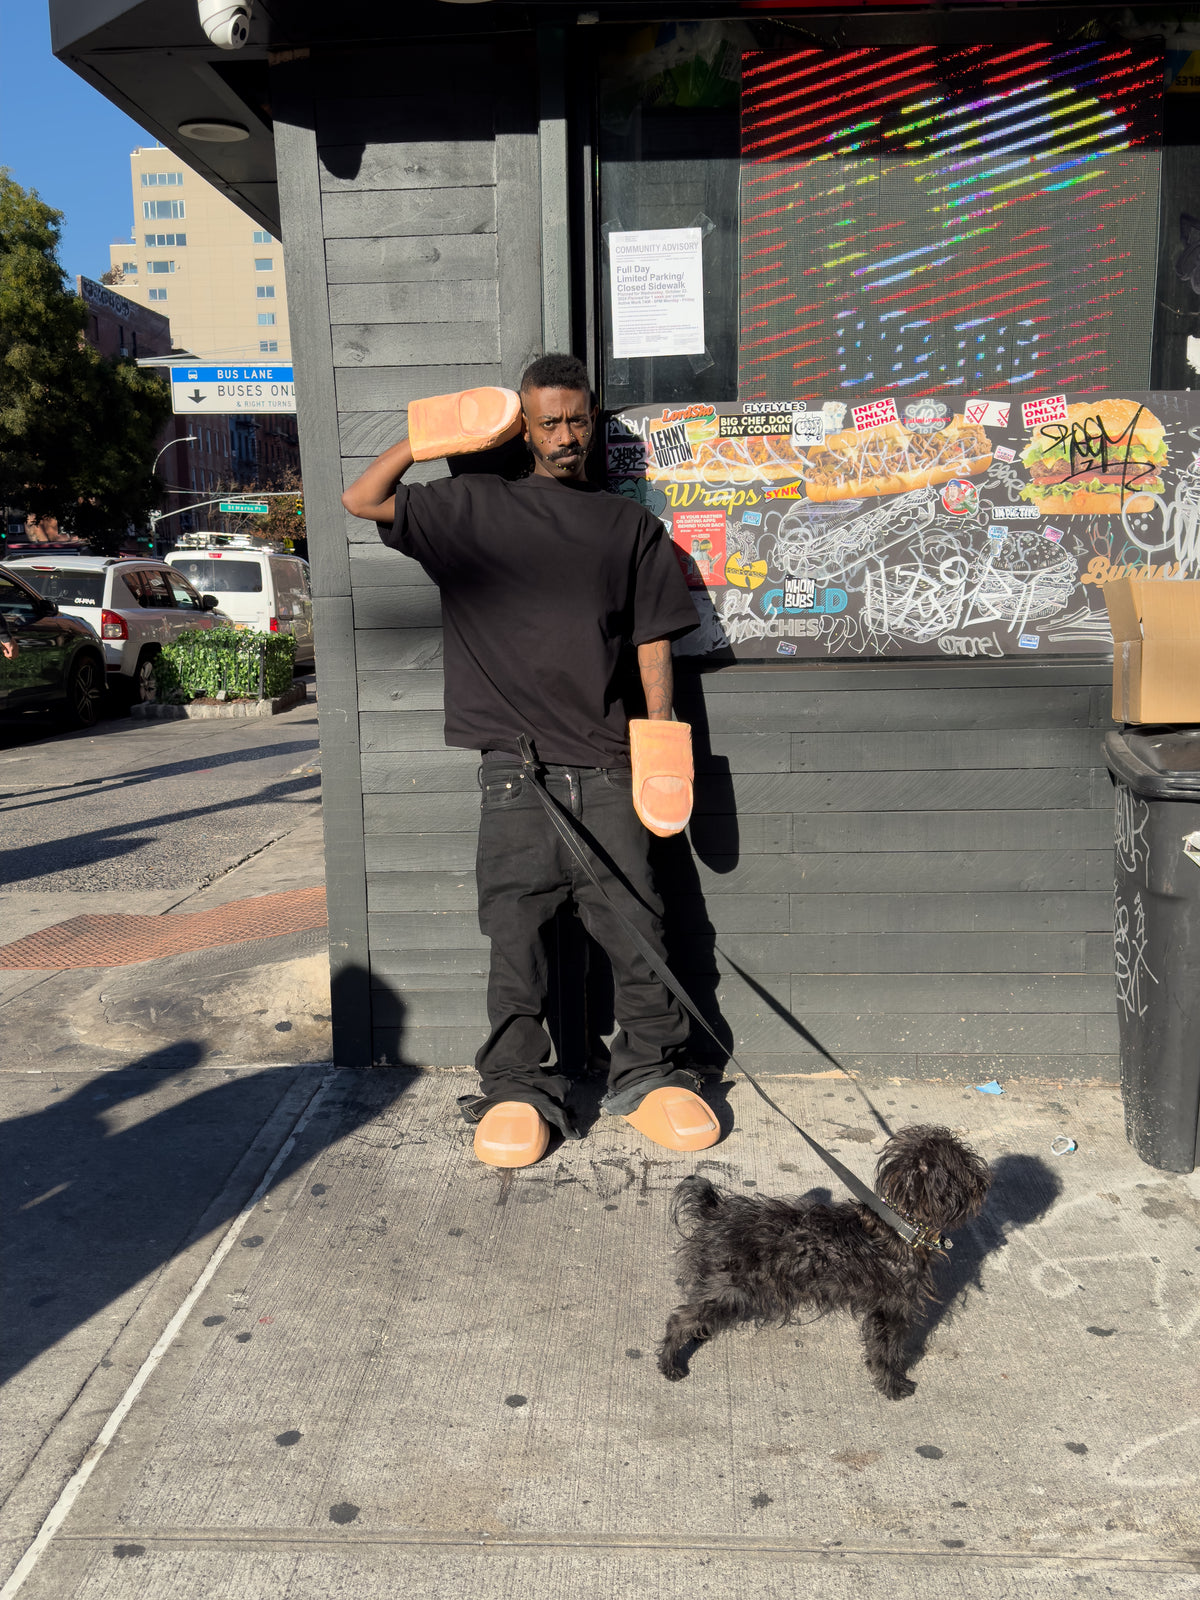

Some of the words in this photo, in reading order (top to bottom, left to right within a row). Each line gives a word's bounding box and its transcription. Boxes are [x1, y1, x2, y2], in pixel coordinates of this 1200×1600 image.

[616, 244, 660, 254] COMMUNITY
[662, 242, 698, 252] ADVISORY
[634, 265, 650, 274] Day
[617, 274, 648, 283] Limited
[650, 272, 684, 282] Parking/
[617, 284, 646, 292] Closed
[648, 281, 686, 290] Sidewalk
[217, 370, 239, 379] BUS
[244, 370, 273, 379] LANE
[218, 385, 262, 396] BUSES
[271, 385, 296, 396] ONL
[745, 403, 806, 412] FLYFLYLES
[854, 399, 894, 415] INFOE
[1024, 396, 1064, 410] INFOE
[856, 406, 896, 422] ONLY1
[1025, 404, 1065, 419] ONLY1
[720, 416, 738, 426] BIG
[741, 416, 766, 425] CHEF
[769, 415, 792, 424] DOG
[857, 415, 897, 431] BRUHA
[1026, 412, 1066, 426] BRUHA
[720, 426, 745, 435] STAY
[747, 424, 790, 434] COOKIN
[651, 424, 687, 450] LENNY
[655, 442, 693, 468] VUITTON
[665, 483, 762, 515] Wraps
[766, 486, 798, 500] SYNK
[785, 578, 815, 593] WHOM
[760, 588, 848, 614] CLD
[785, 592, 814, 608] BUBS
